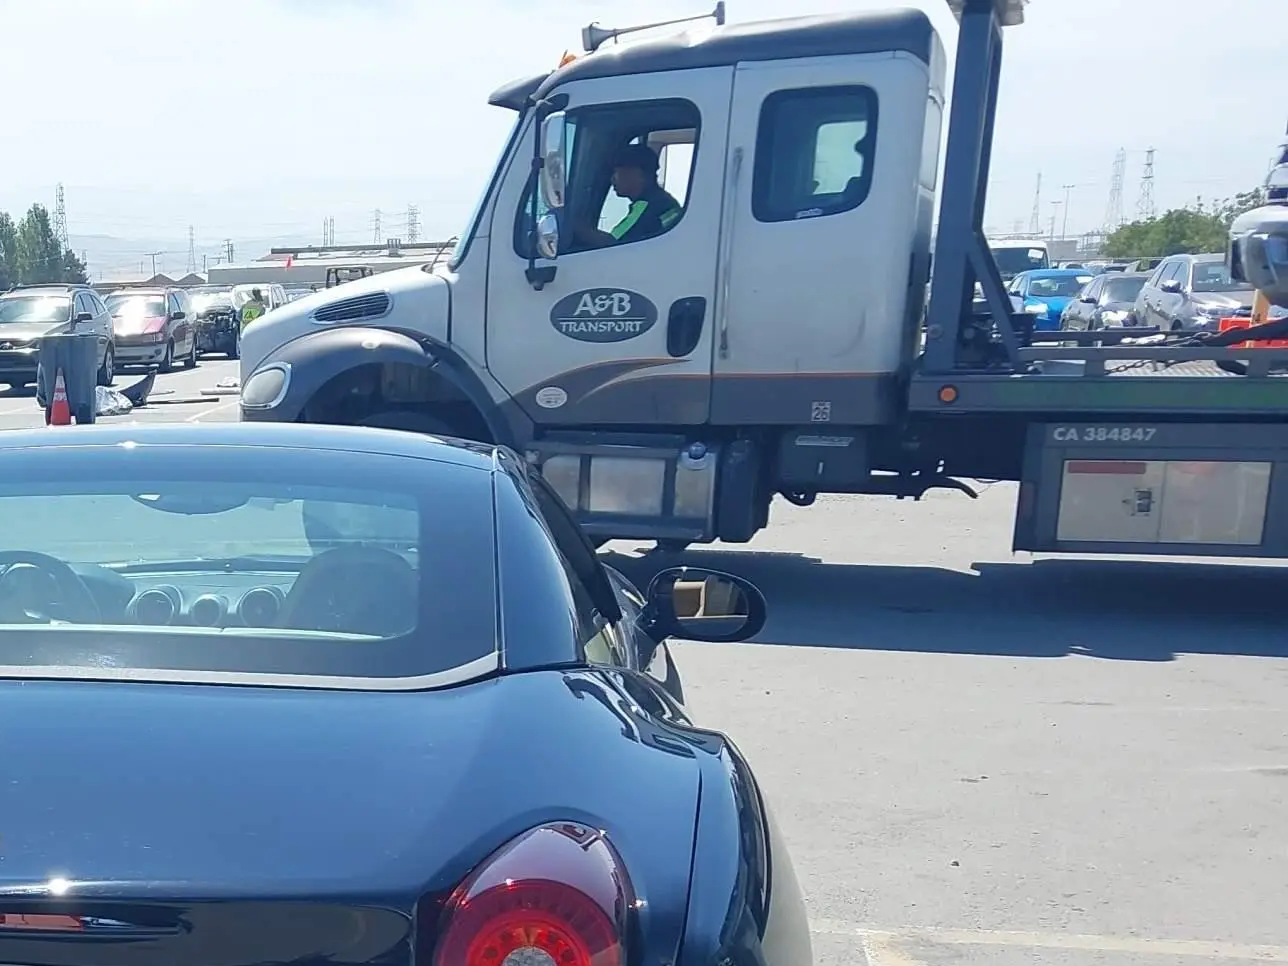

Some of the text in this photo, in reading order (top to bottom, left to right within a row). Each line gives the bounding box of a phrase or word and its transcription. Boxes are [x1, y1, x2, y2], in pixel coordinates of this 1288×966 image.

[573, 292, 631, 316] A&B
[559, 321, 643, 333] TRANSPORT
[1053, 427, 1157, 441] CA 384847
